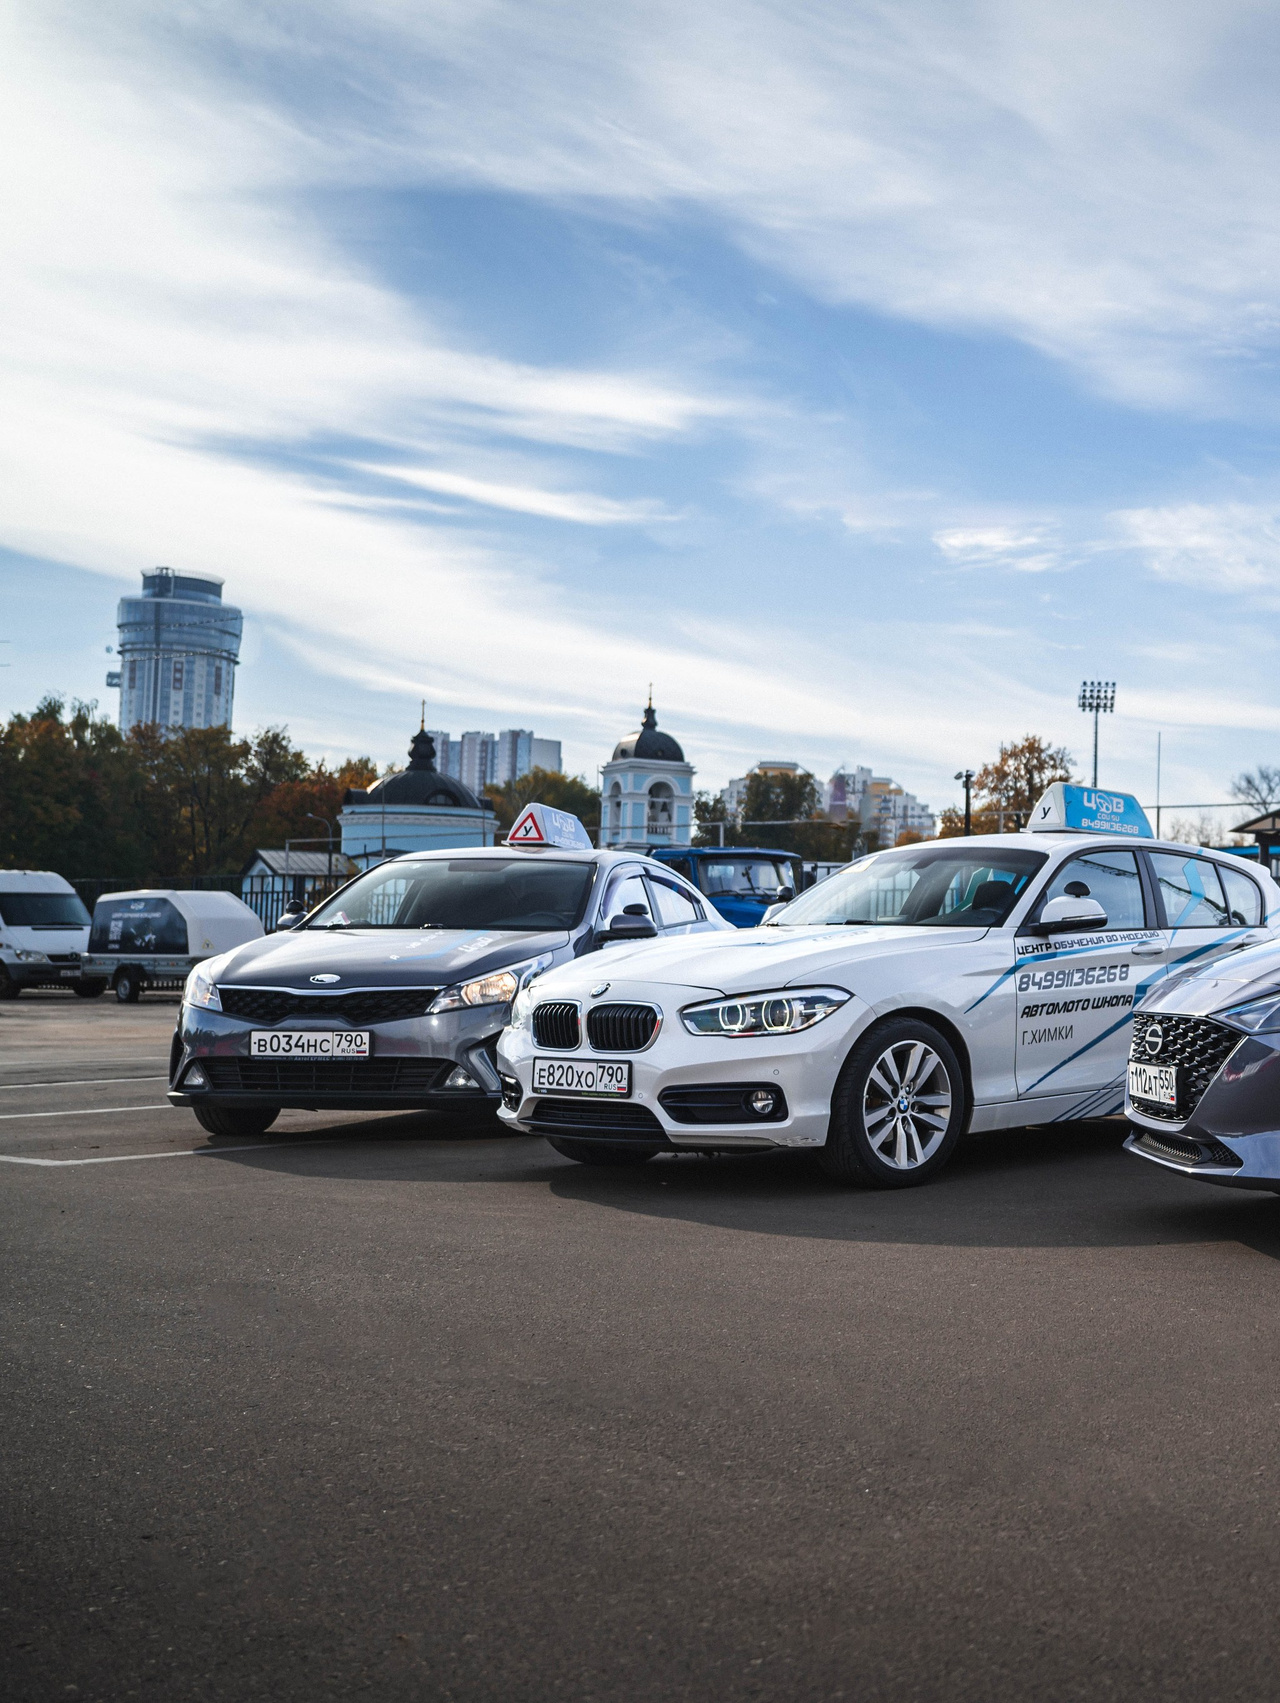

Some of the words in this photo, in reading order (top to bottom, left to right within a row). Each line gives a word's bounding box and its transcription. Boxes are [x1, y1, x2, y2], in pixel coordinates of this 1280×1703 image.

[1081, 818, 1139, 834] 84991136268
[1016, 942, 1052, 956] ЦЕНТР
[1054, 936, 1105, 950] ОБУЧЕНИЯ
[1018, 964, 1130, 993] 84991136268
[1020, 998, 1091, 1019] АВТОМОТО
[1091, 994, 1134, 1010] ШКОЛА
[257, 1034, 331, 1053] В034НС
[334, 1033, 364, 1048] 790
[1022, 1024, 1074, 1046] Г.ХИМКИ
[538, 1063, 595, 1089] Е820ХО
[598, 1065, 624, 1084] 790
[603, 1083, 617, 1091] RUS
